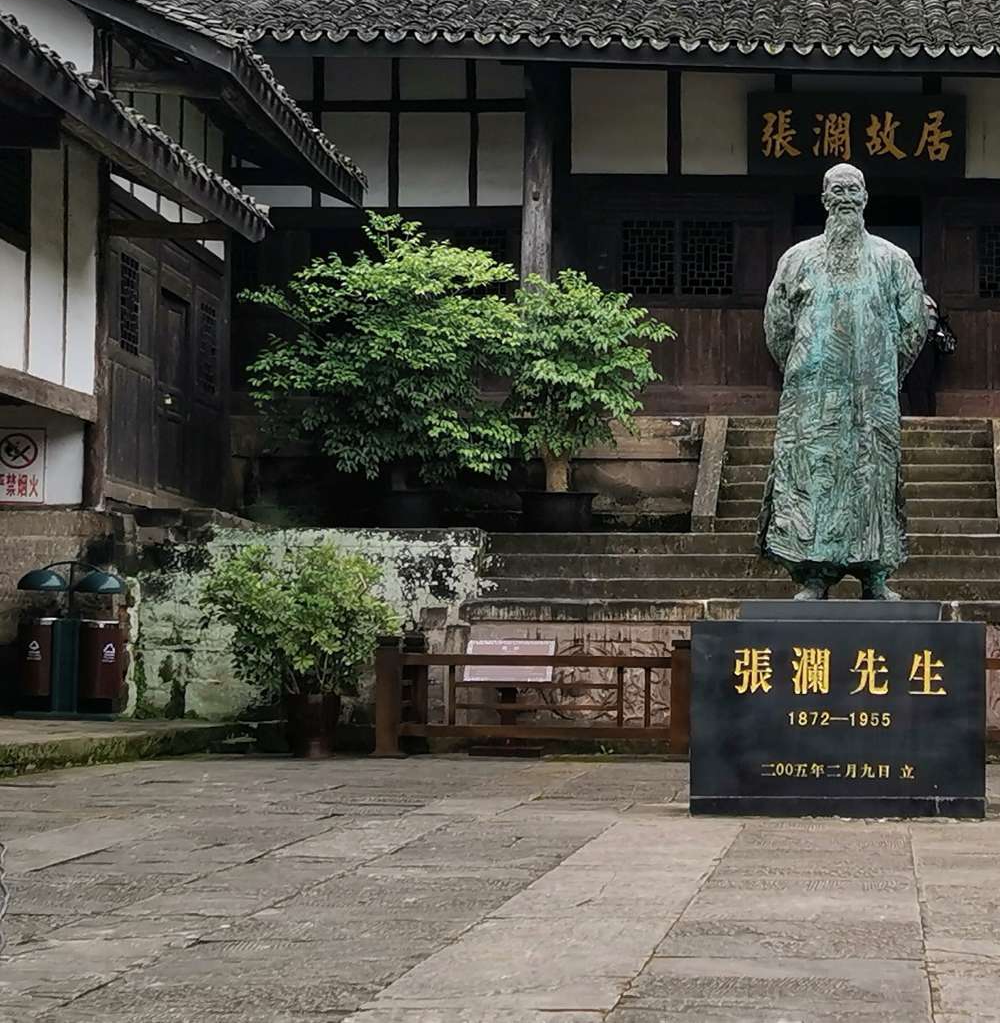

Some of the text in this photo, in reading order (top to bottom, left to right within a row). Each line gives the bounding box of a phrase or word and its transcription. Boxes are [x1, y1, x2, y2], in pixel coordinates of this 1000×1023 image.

[761, 109, 953, 162] 張瀾故居
[734, 647, 947, 695] 張瀾先生
